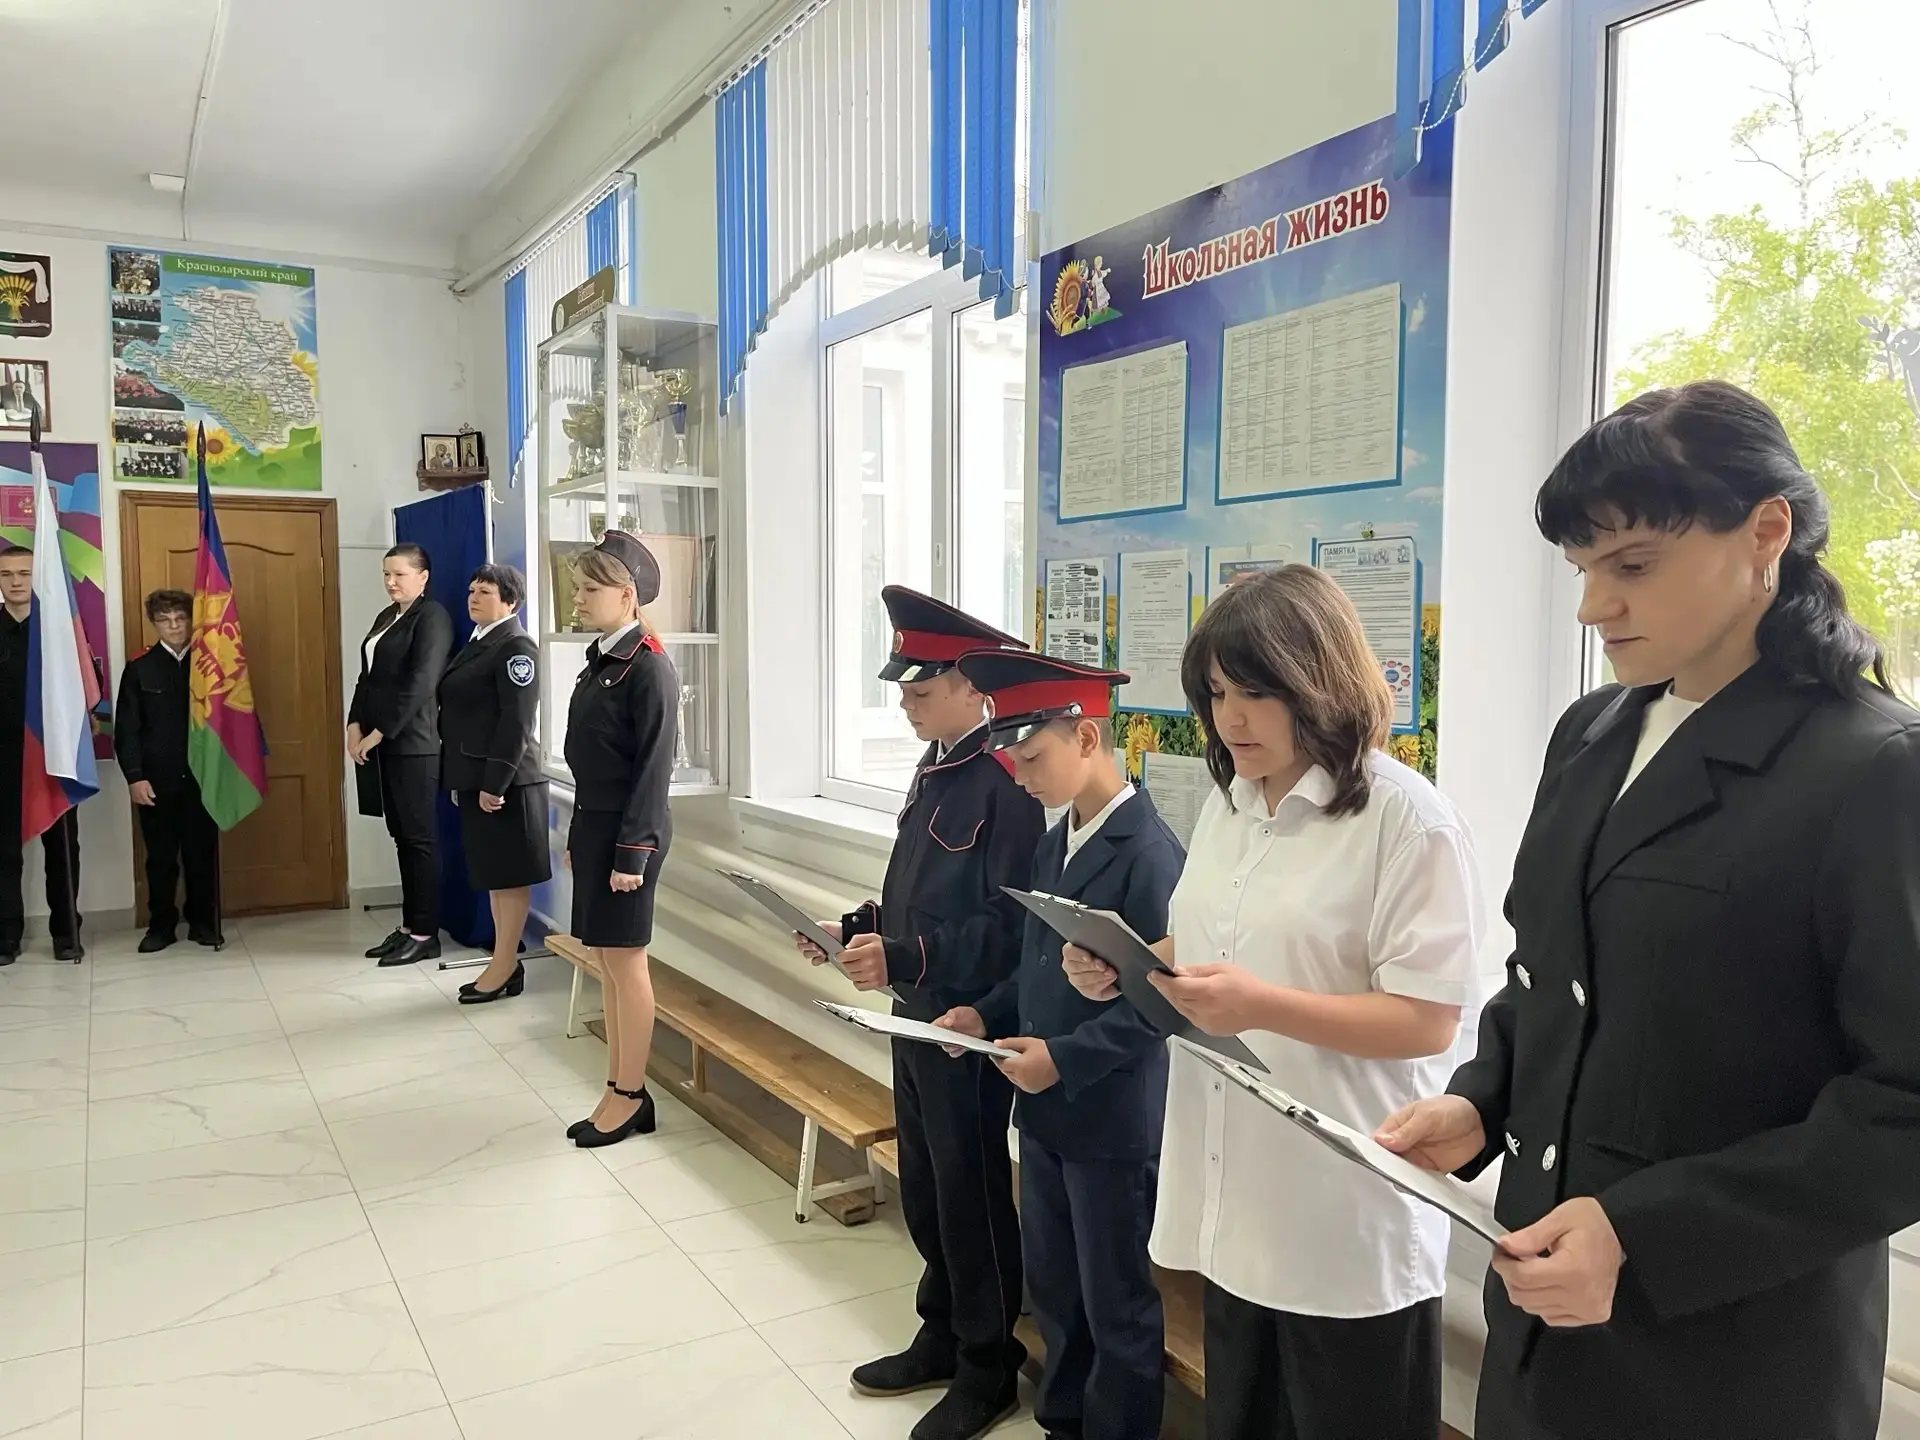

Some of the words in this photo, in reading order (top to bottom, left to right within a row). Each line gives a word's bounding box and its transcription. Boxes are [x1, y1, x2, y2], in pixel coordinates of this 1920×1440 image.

[1142, 214, 1280, 299] Школьная
[1281, 178, 1390, 254] жизнь
[176, 258, 268, 278] Краснодарский
[270, 271, 298, 282] край
[1323, 547, 1356, 556] ПАМЯТКА
